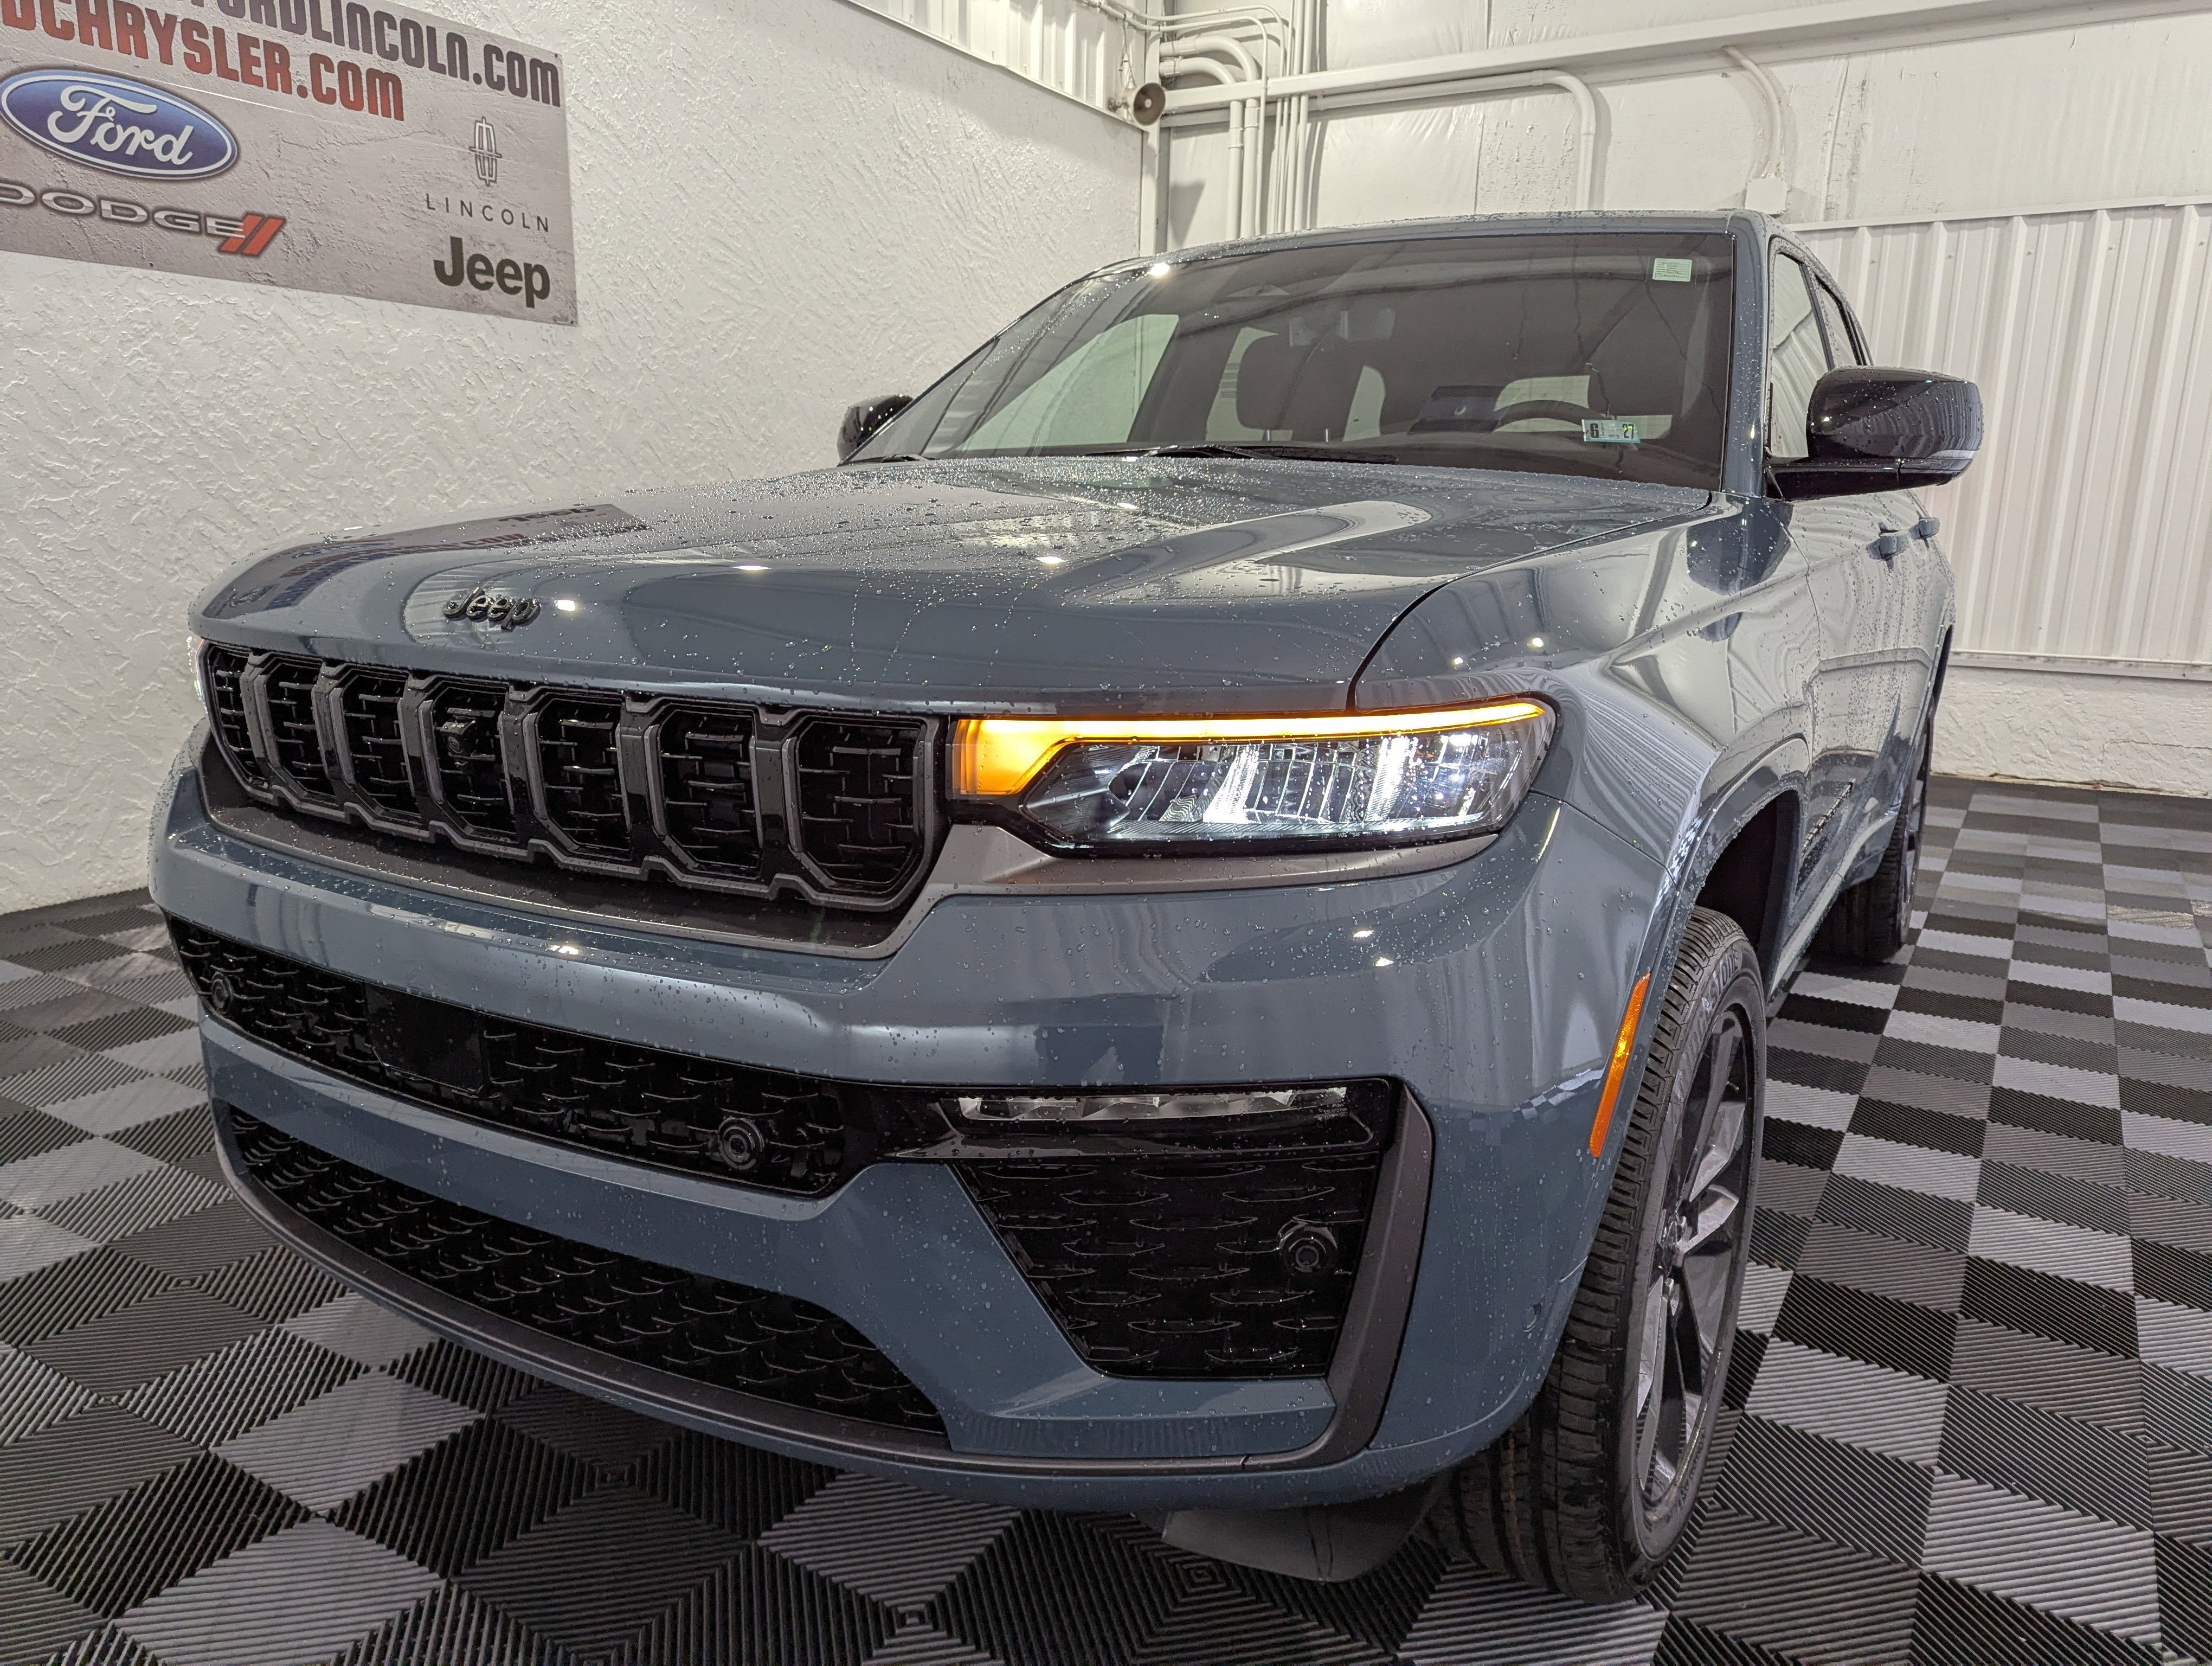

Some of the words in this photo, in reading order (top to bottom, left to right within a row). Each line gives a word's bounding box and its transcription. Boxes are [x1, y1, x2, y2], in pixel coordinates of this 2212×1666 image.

[191, 0, 561, 107] DLINCOLN.COM
[47, 85, 194, 165] Ford
[0, 182, 246, 239] DODGE
[426, 193, 548, 232] LINCOLN
[433, 236, 550, 309] Jeep
[1590, 423, 1599, 438] 6
[1622, 424, 1634, 439] 27
[443, 586, 541, 630] Jeep
